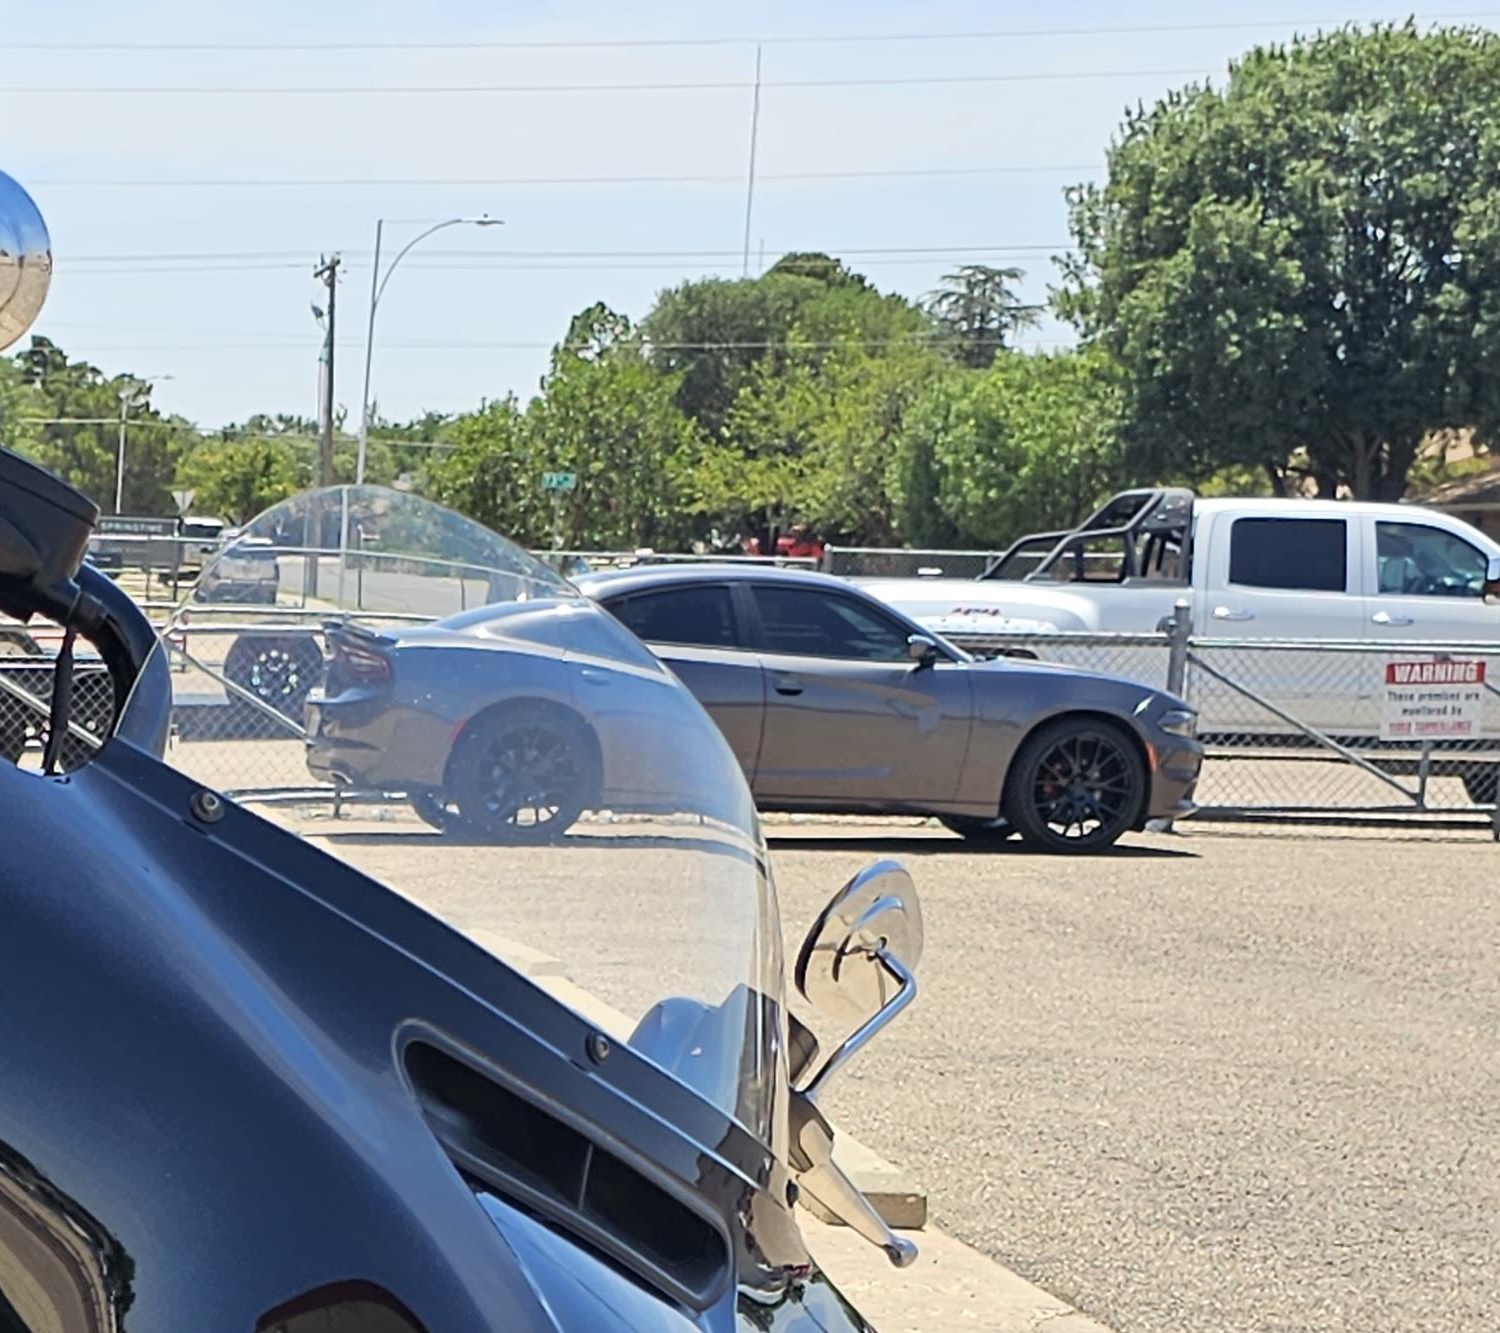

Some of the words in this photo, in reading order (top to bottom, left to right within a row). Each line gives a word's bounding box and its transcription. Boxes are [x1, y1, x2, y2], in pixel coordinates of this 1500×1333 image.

[1394, 663, 1478, 682] WARNING
[1388, 691, 1414, 701] These
[1418, 692, 1460, 703] premises
[1465, 692, 1479, 701] are
